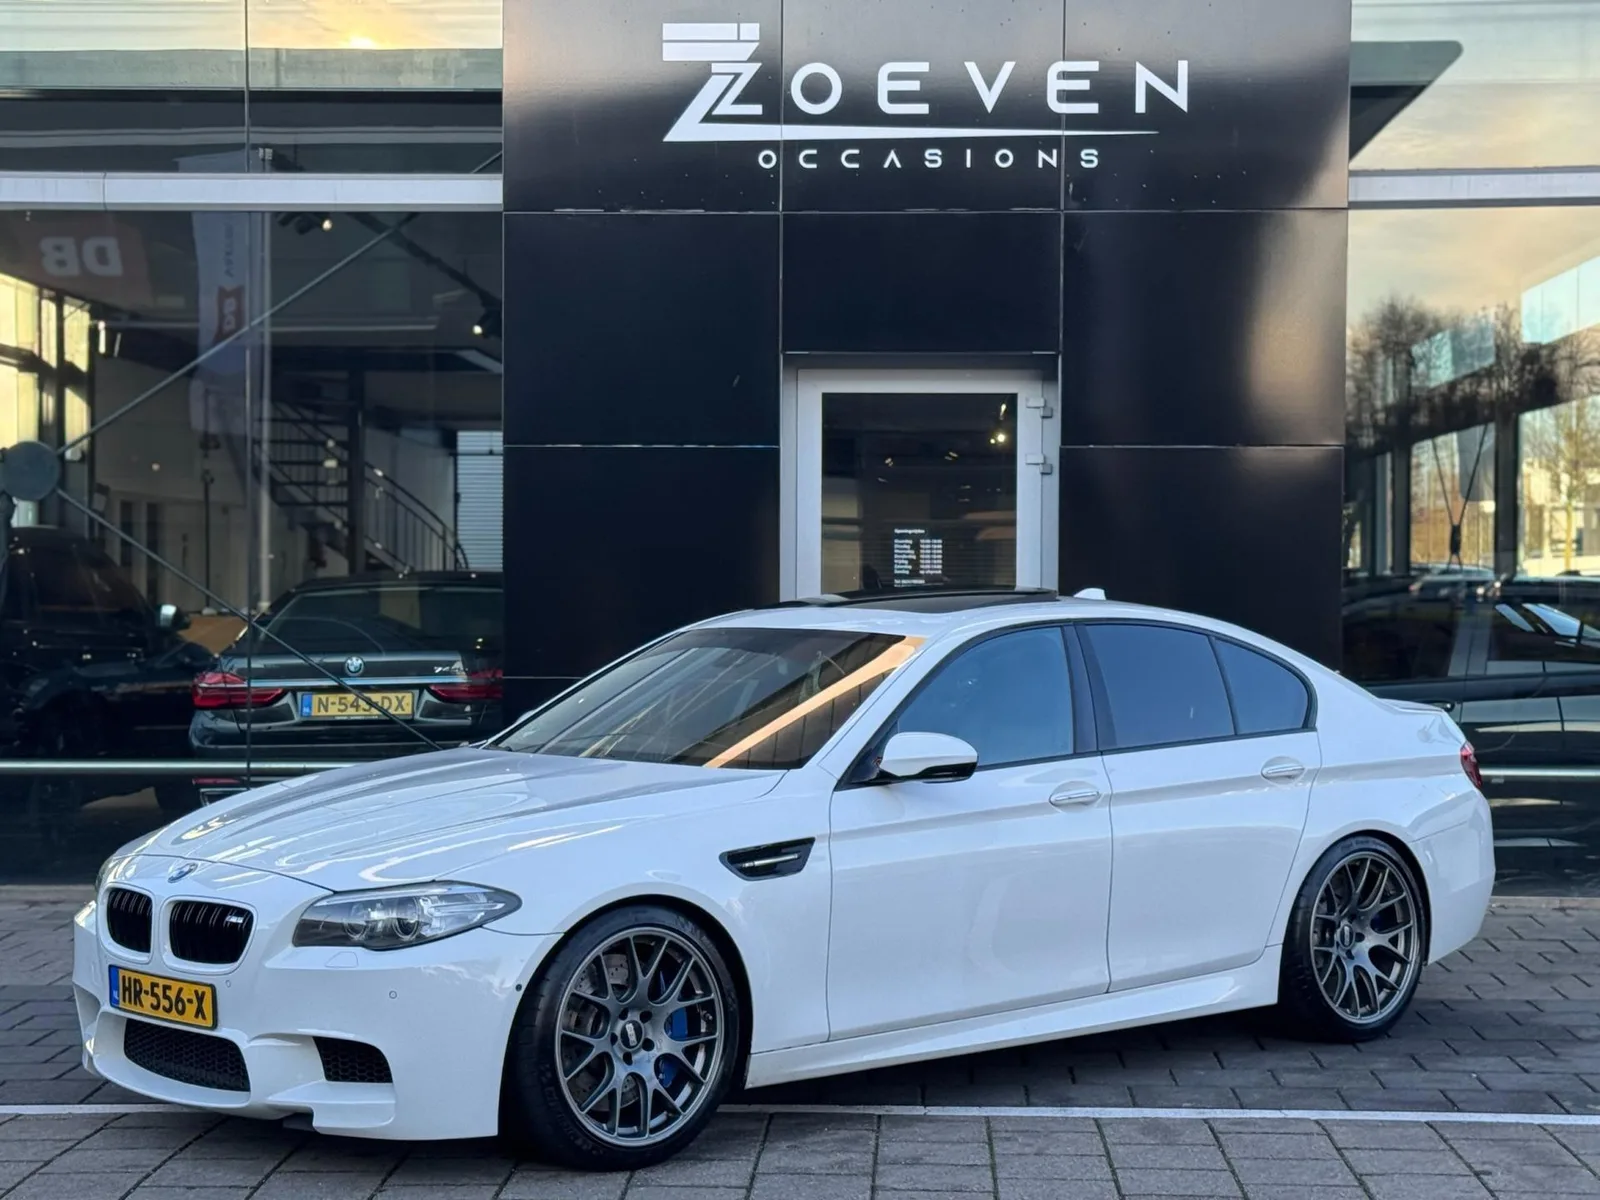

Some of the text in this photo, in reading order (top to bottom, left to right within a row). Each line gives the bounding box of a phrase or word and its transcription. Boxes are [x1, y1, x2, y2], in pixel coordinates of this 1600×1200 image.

[662, 23, 1189, 142] ZOEVEN
[758, 149, 1100, 169] OCCASIONS
[122, 975, 207, 1020] HR-556-X
